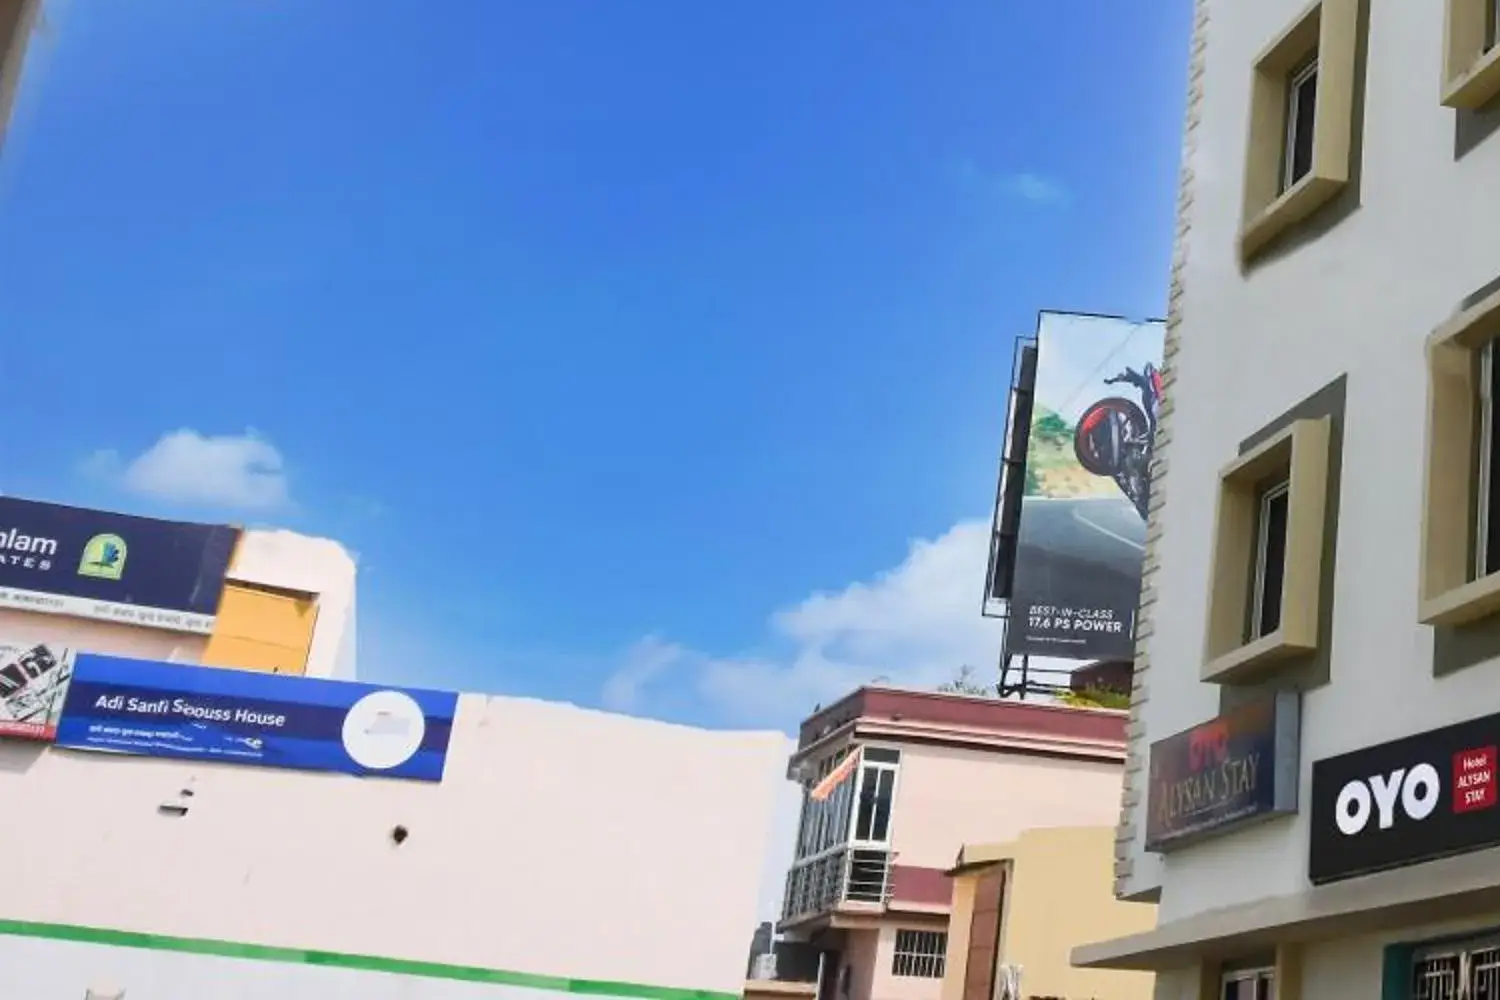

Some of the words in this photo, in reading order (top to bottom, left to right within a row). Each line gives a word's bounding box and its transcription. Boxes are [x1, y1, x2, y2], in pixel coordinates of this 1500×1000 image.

[1054, 618, 1070, 629] PS
[1073, 620, 1122, 632] POWER
[235, 709, 286, 727] House
[1220, 751, 1261, 801] STAY
[1457, 769, 1491, 789] ALYSAN
[1335, 762, 1440, 835] OYO
